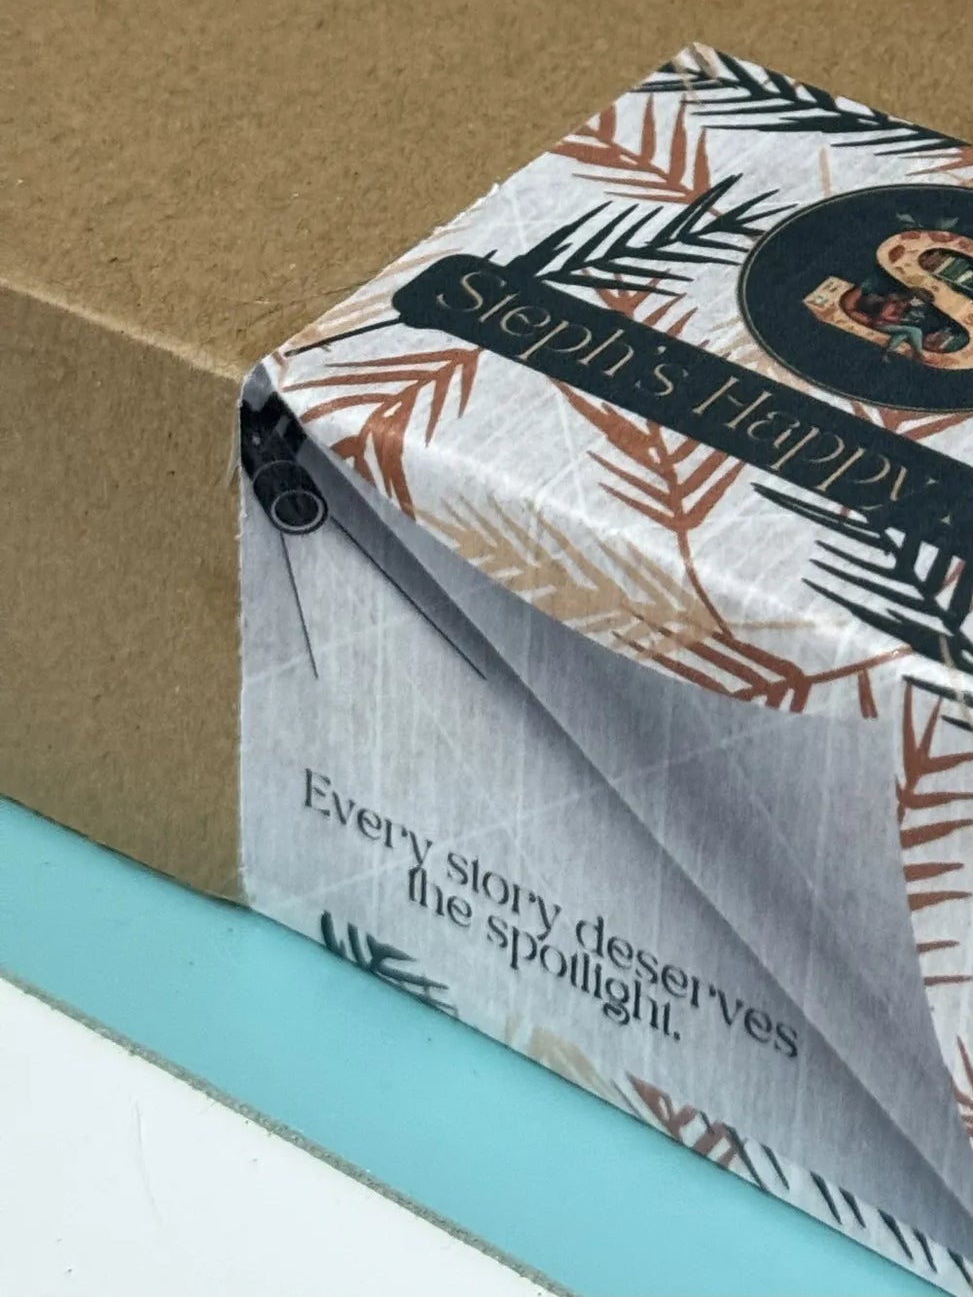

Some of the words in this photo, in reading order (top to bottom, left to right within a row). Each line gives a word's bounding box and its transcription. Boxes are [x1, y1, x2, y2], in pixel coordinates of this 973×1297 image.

[436, 270, 690, 397] Steph's
[692, 376, 937, 513] Happy
[303, 768, 433, 866] Every
[446, 849, 562, 941] story
[575, 915, 799, 1059] deserves
[407, 867, 473, 928] the
[487, 910, 682, 1042] spotlight.
